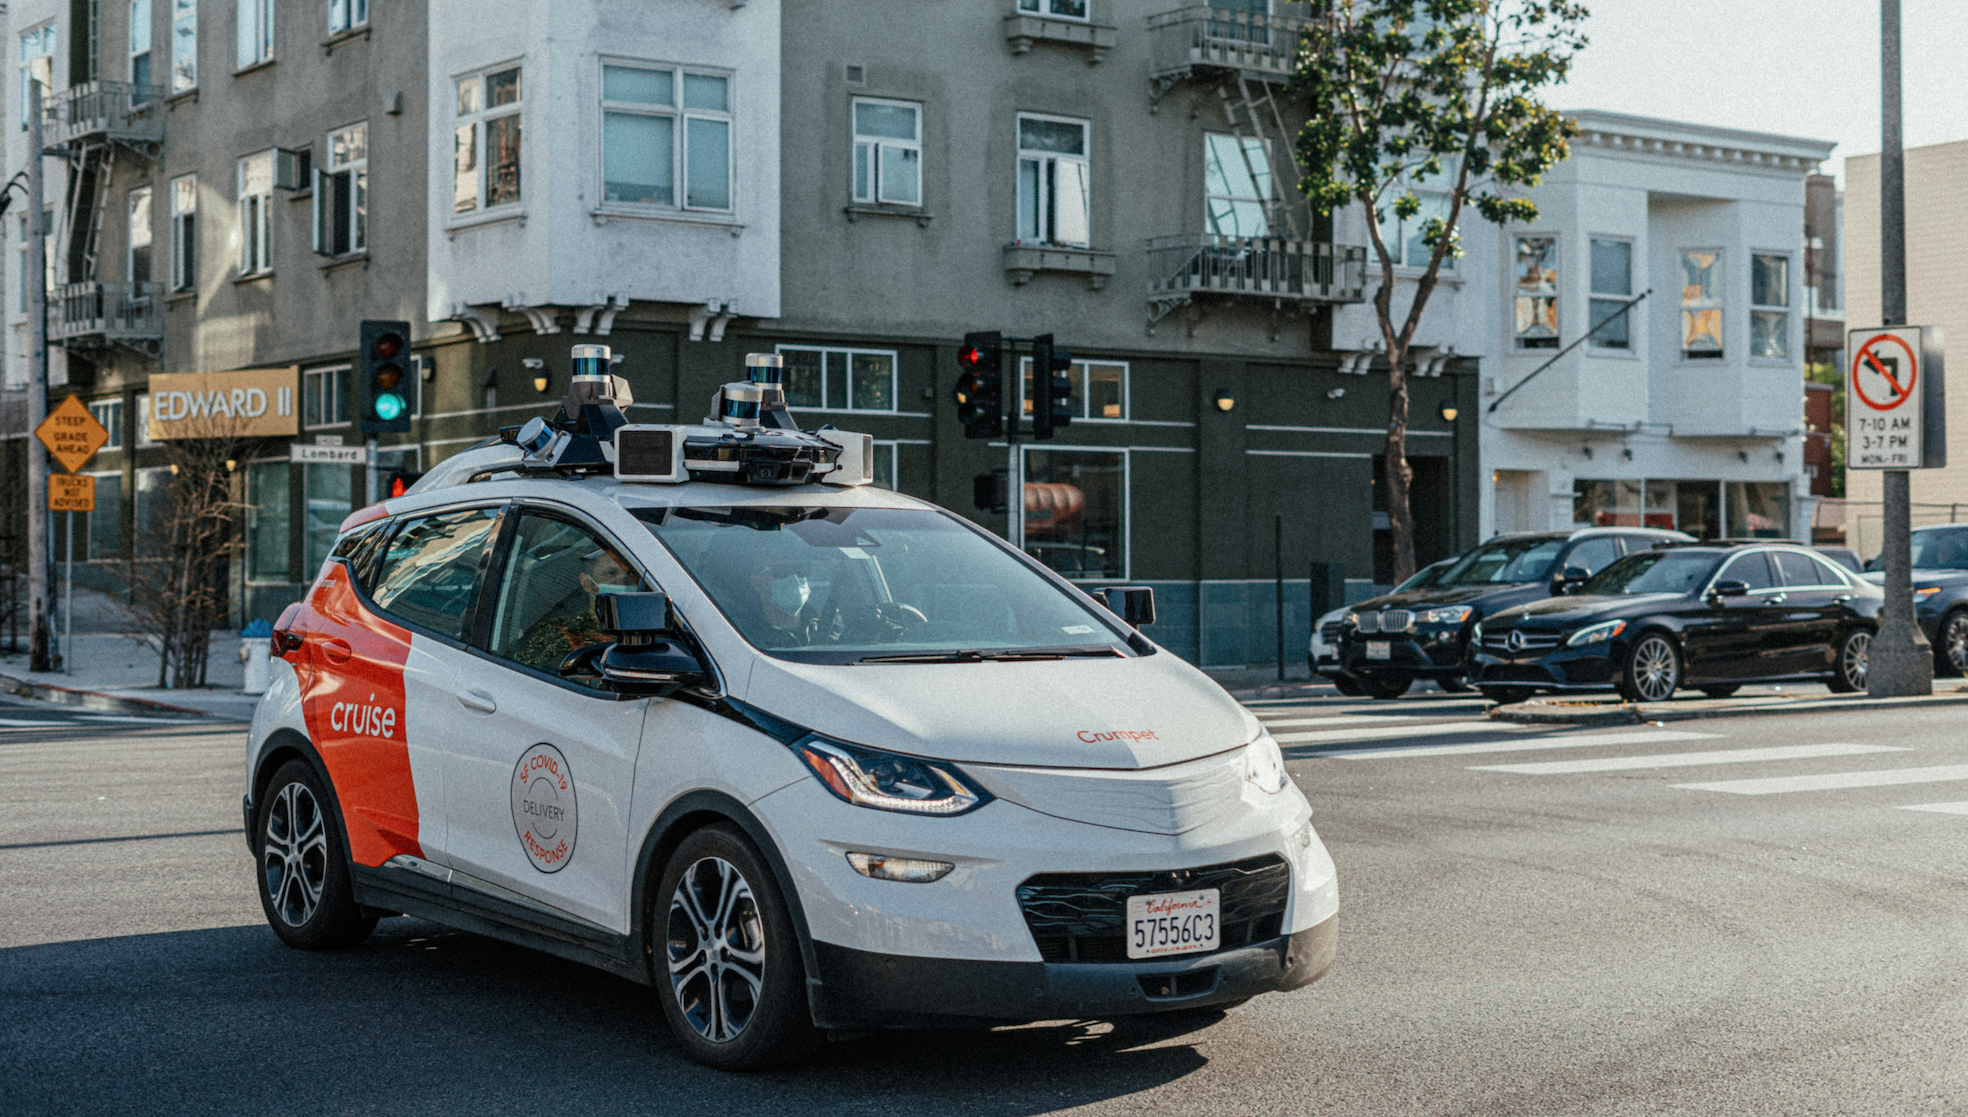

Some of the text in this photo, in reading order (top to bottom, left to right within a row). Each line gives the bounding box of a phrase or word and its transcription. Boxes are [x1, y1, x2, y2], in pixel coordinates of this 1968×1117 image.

[155, 388, 268, 420] EDWARD
[55, 416, 86, 426] STEEP
[1859, 417, 1911, 431] 7-10 AM
[54, 432, 88, 442] GRADE
[1863, 435, 1907, 449] 3-7 PM
[56, 444, 90, 454] AHEAD
[302, 449, 357, 460] Lombard
[56, 477, 88, 488] TRUCKS
[64, 488, 80, 497] NOT
[53, 498, 90, 508] ADVISED
[331, 692, 396, 739] cruise
[1077, 729, 1160, 744] Crumpet
[520, 755, 567, 790] SF COVID-19
[523, 799, 565, 822] DELIVERY
[523, 830, 568, 864] RESPONSE
[1147, 898, 1204, 916] California
[1135, 913, 1214, 948] 57556C3
[1151, 944, 1198, 953] dmv.ca.gov
